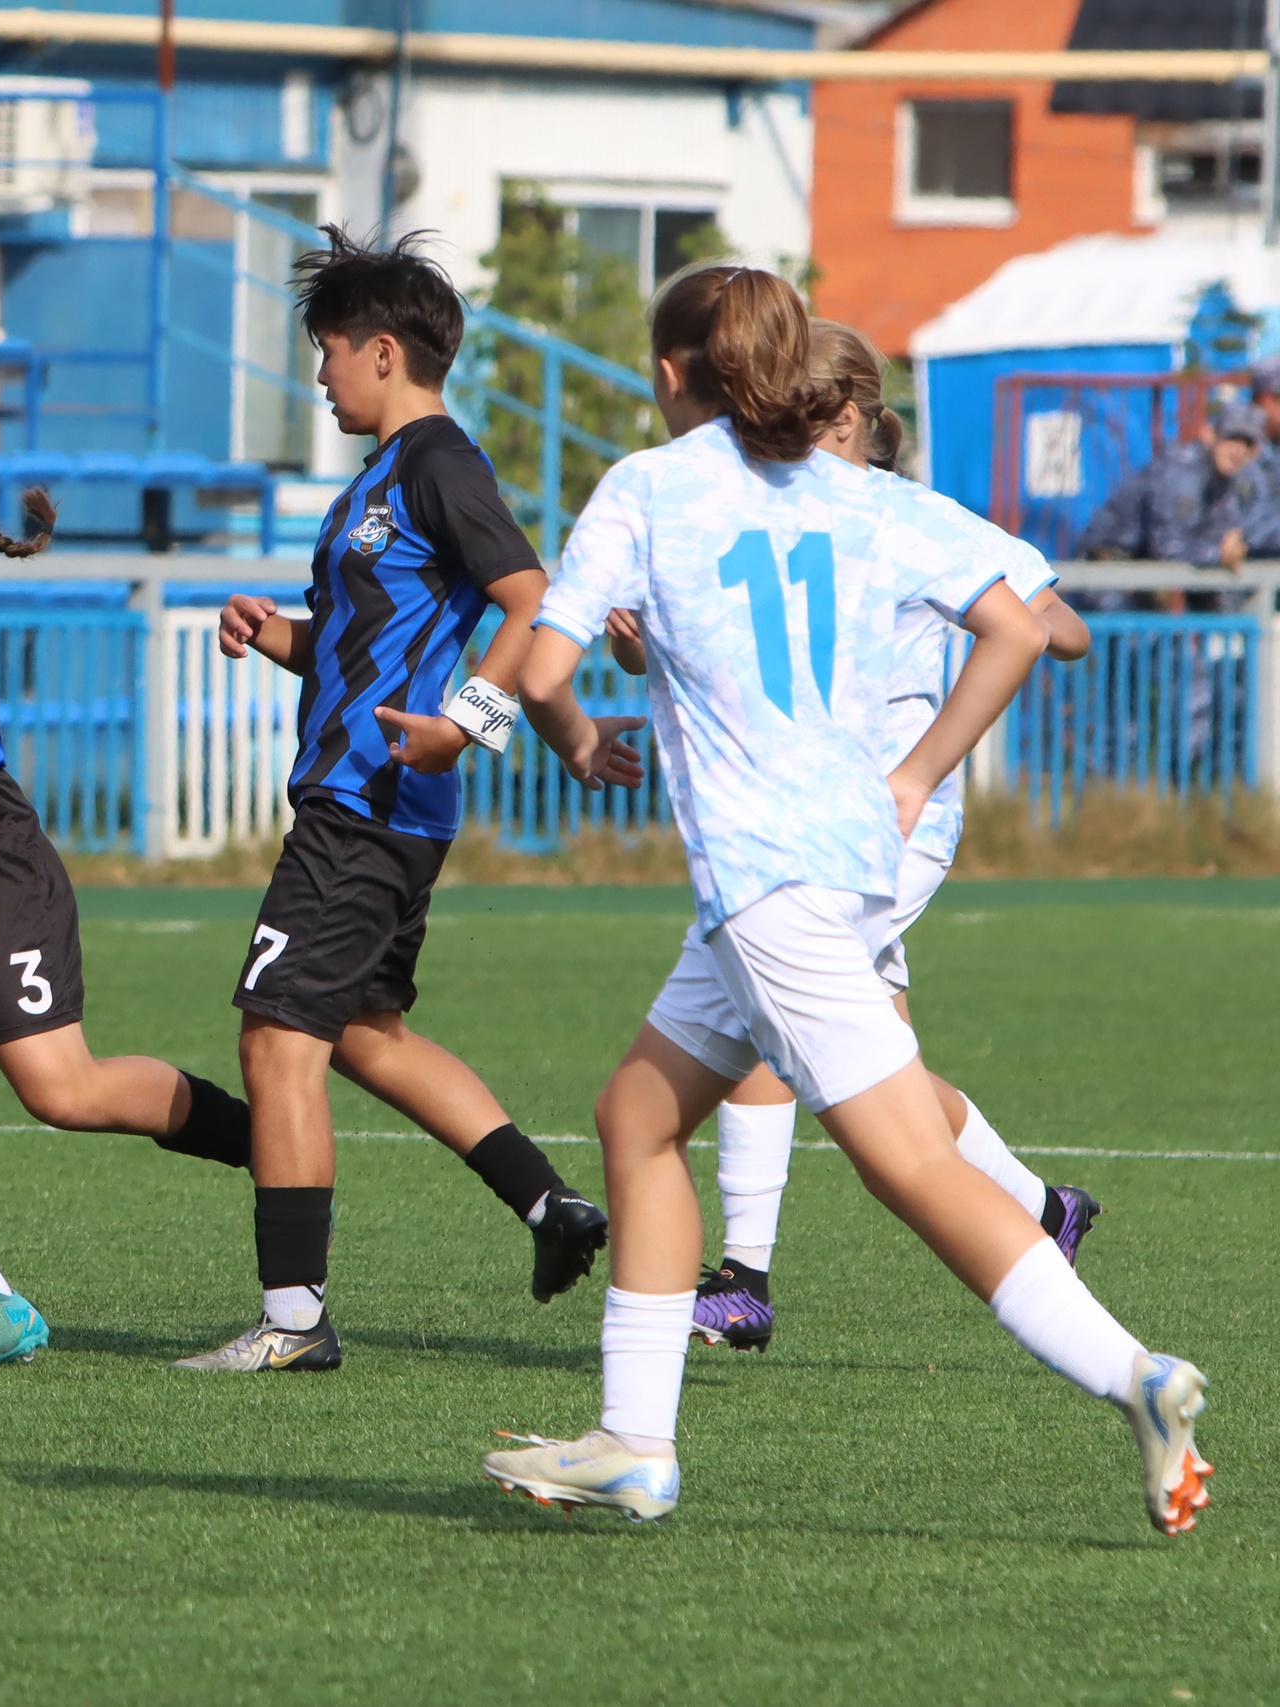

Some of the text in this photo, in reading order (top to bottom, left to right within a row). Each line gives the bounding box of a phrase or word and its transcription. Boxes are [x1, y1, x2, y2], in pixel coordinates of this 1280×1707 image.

[718, 529, 835, 724] 11
[9, 948, 53, 1015] 3
[244, 923, 289, 991] 7
